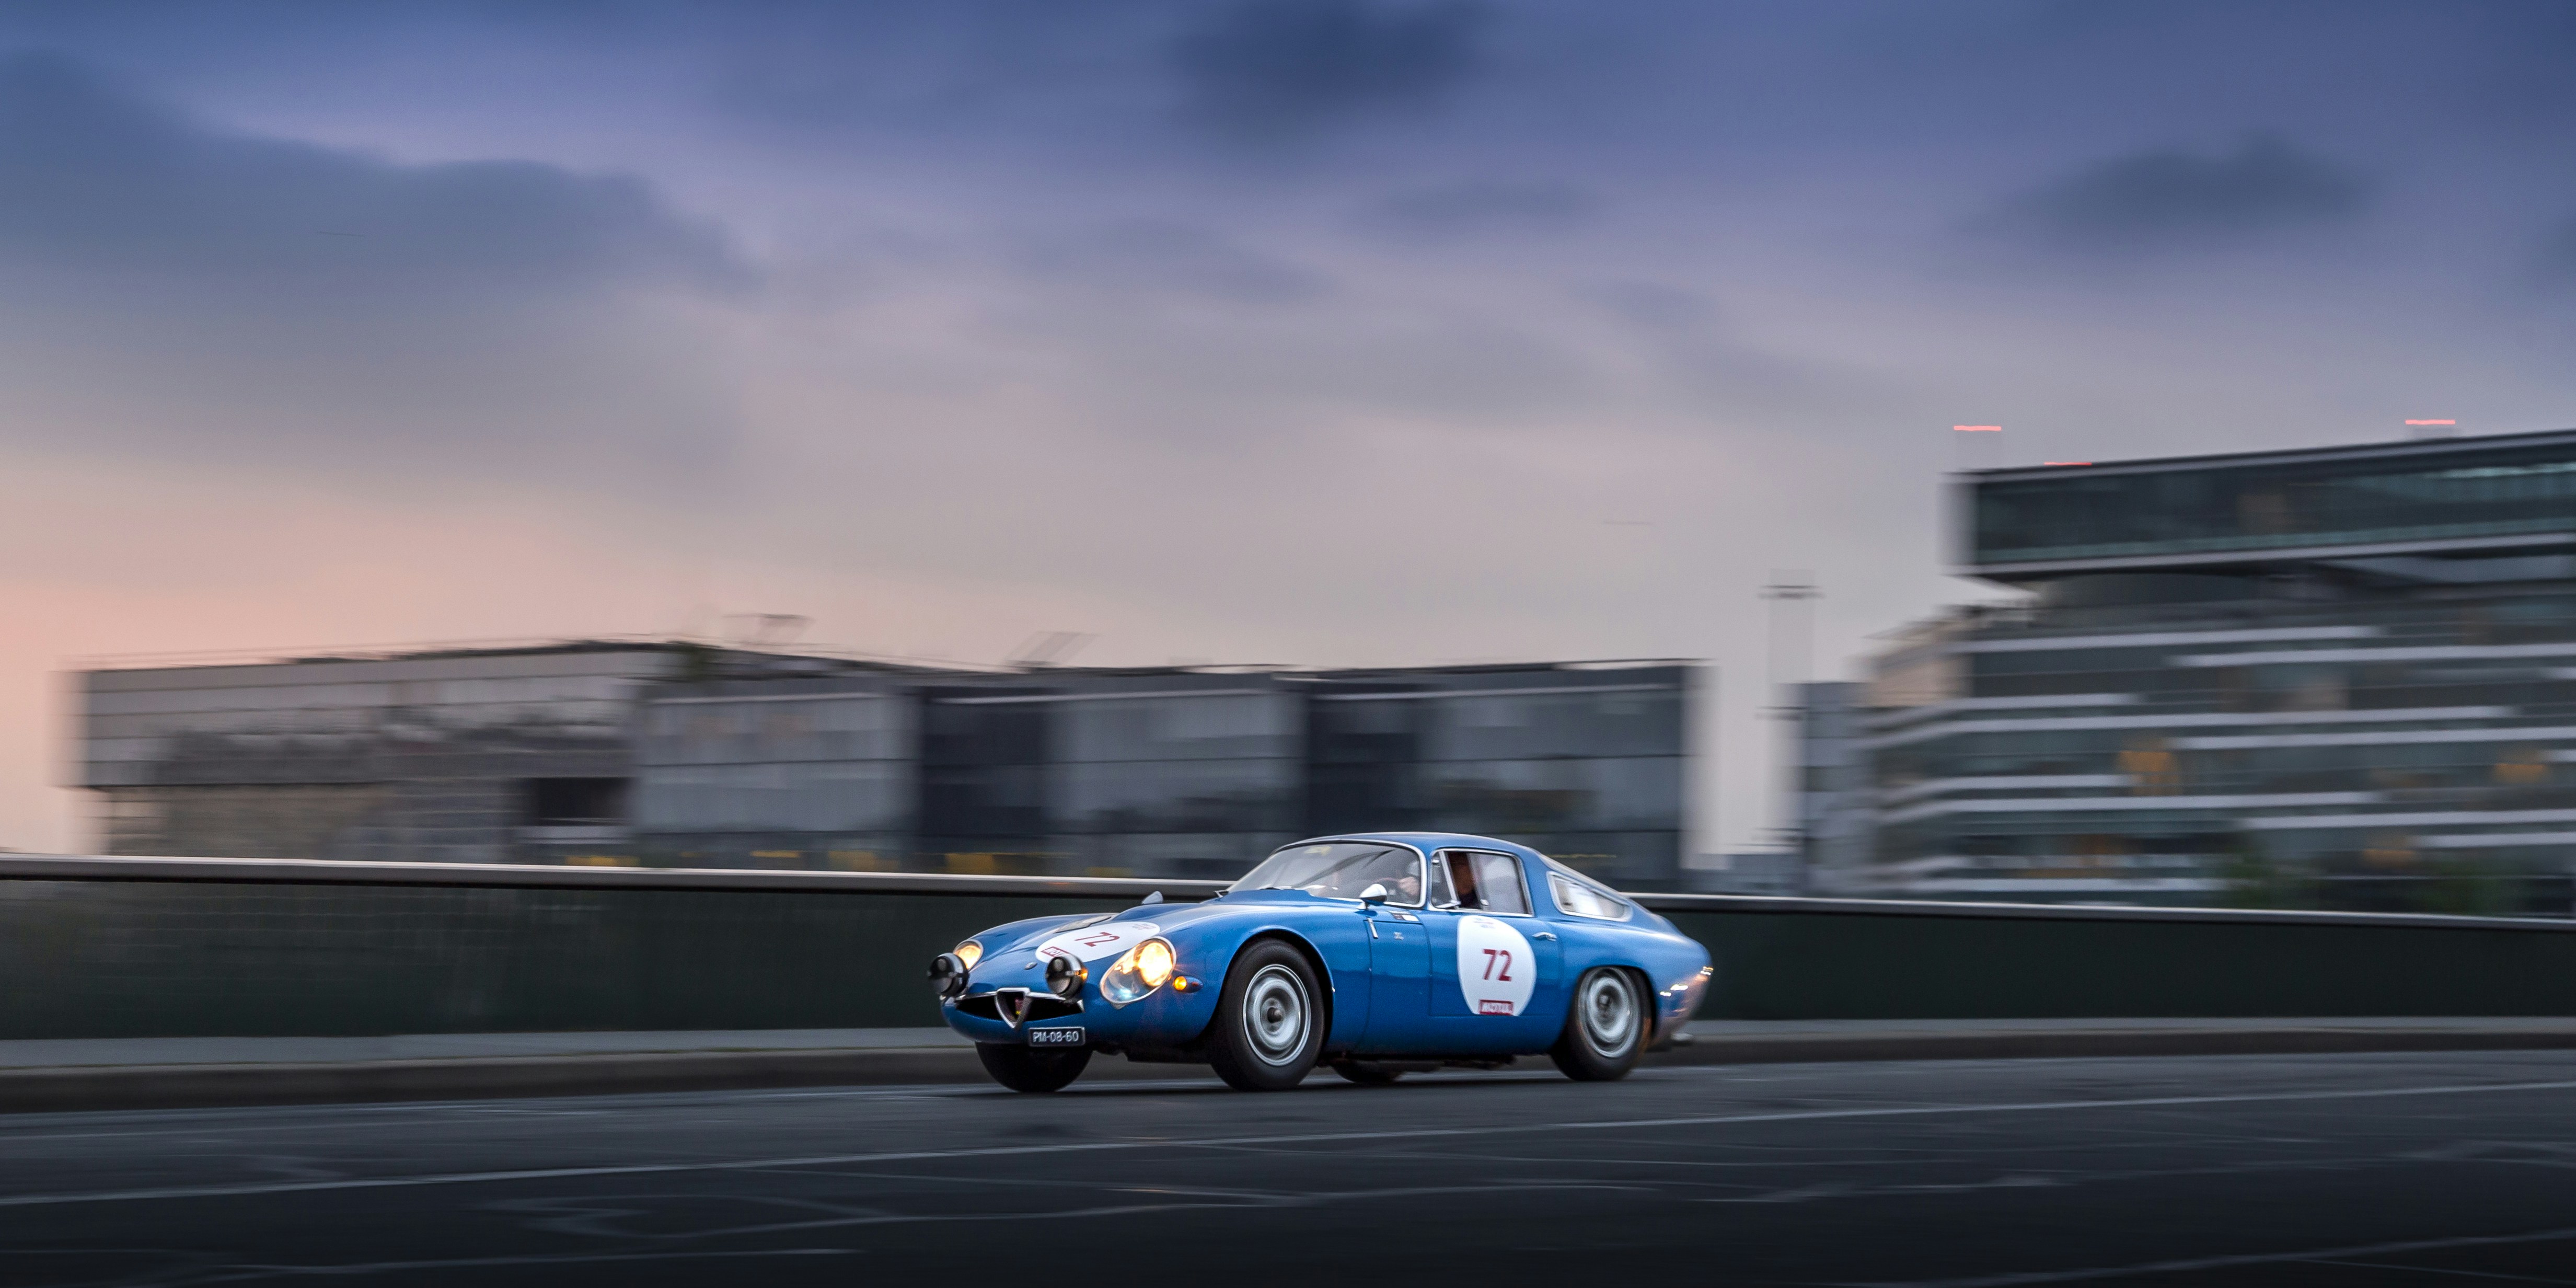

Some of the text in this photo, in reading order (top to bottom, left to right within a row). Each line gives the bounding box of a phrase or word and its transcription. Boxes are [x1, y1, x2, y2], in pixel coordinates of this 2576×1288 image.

[1074, 932, 1120, 947] 72
[1482, 949, 1512, 981] 72
[1033, 1031, 1079, 1042] PM-08-60
